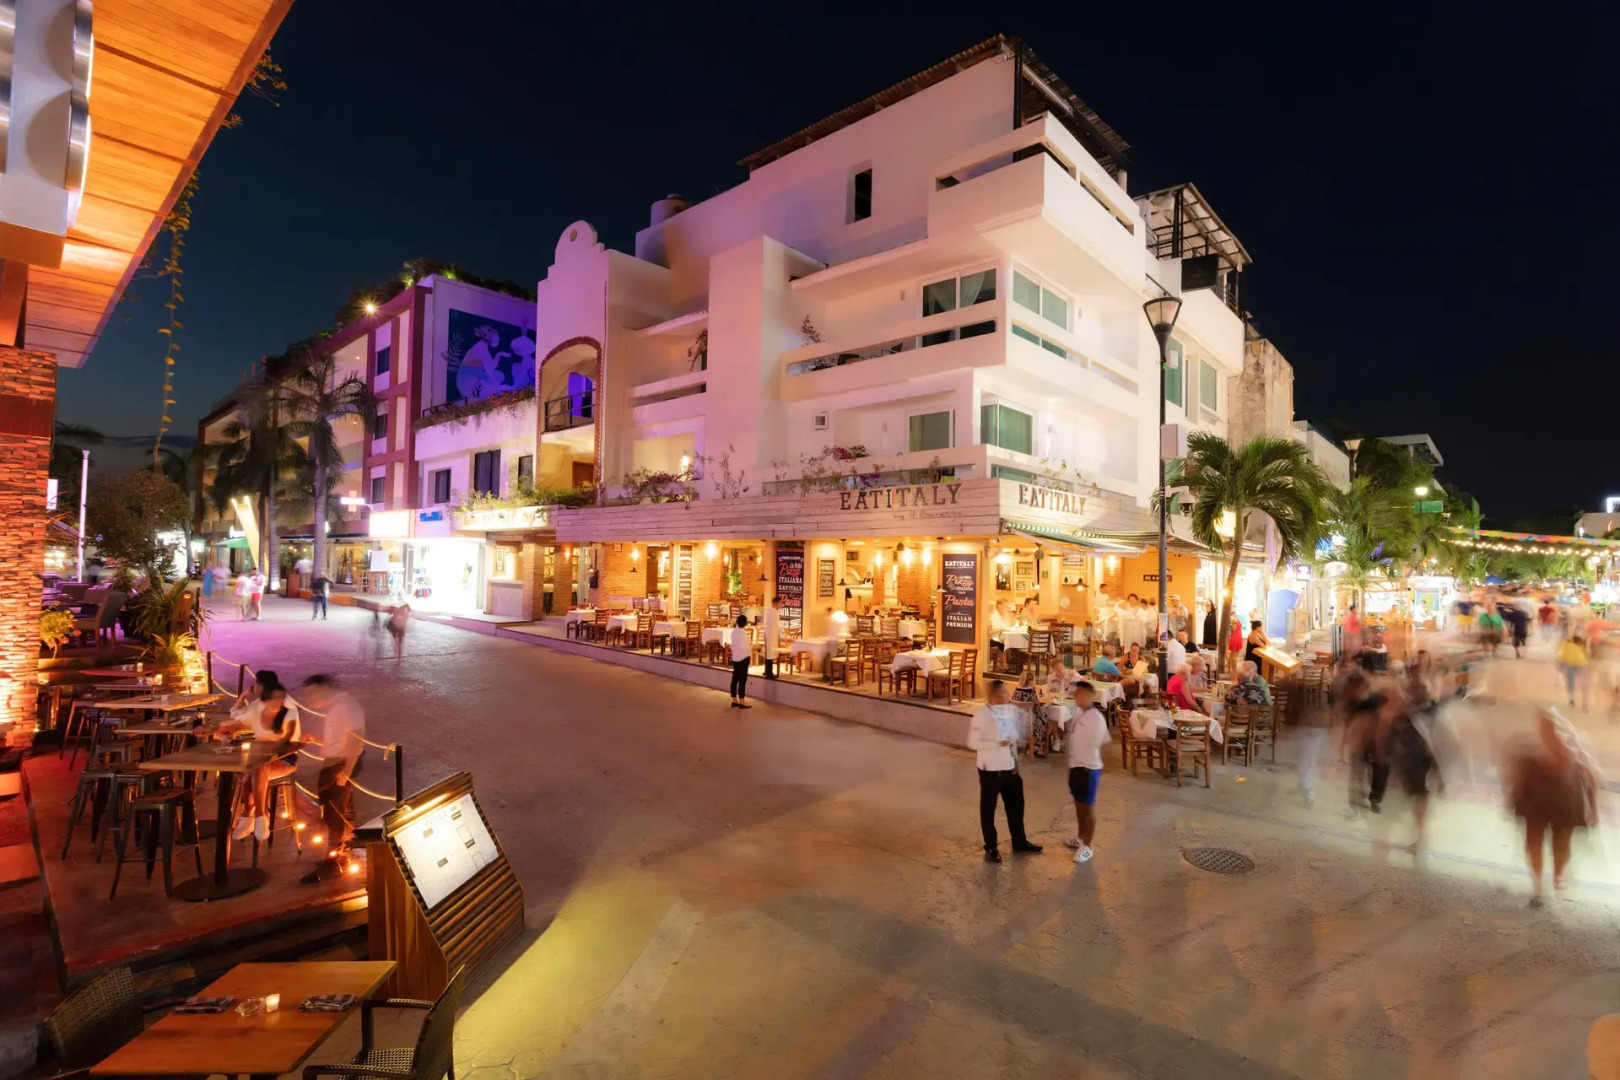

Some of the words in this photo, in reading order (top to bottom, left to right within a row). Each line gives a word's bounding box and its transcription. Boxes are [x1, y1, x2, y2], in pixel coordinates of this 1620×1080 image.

[840, 483, 961, 510] EATITALY
[1019, 484, 1086, 515] EATITALY
[946, 574, 973, 586] Pizza
[779, 594, 801, 607] Pasta
[945, 595, 974, 606] Pasta
